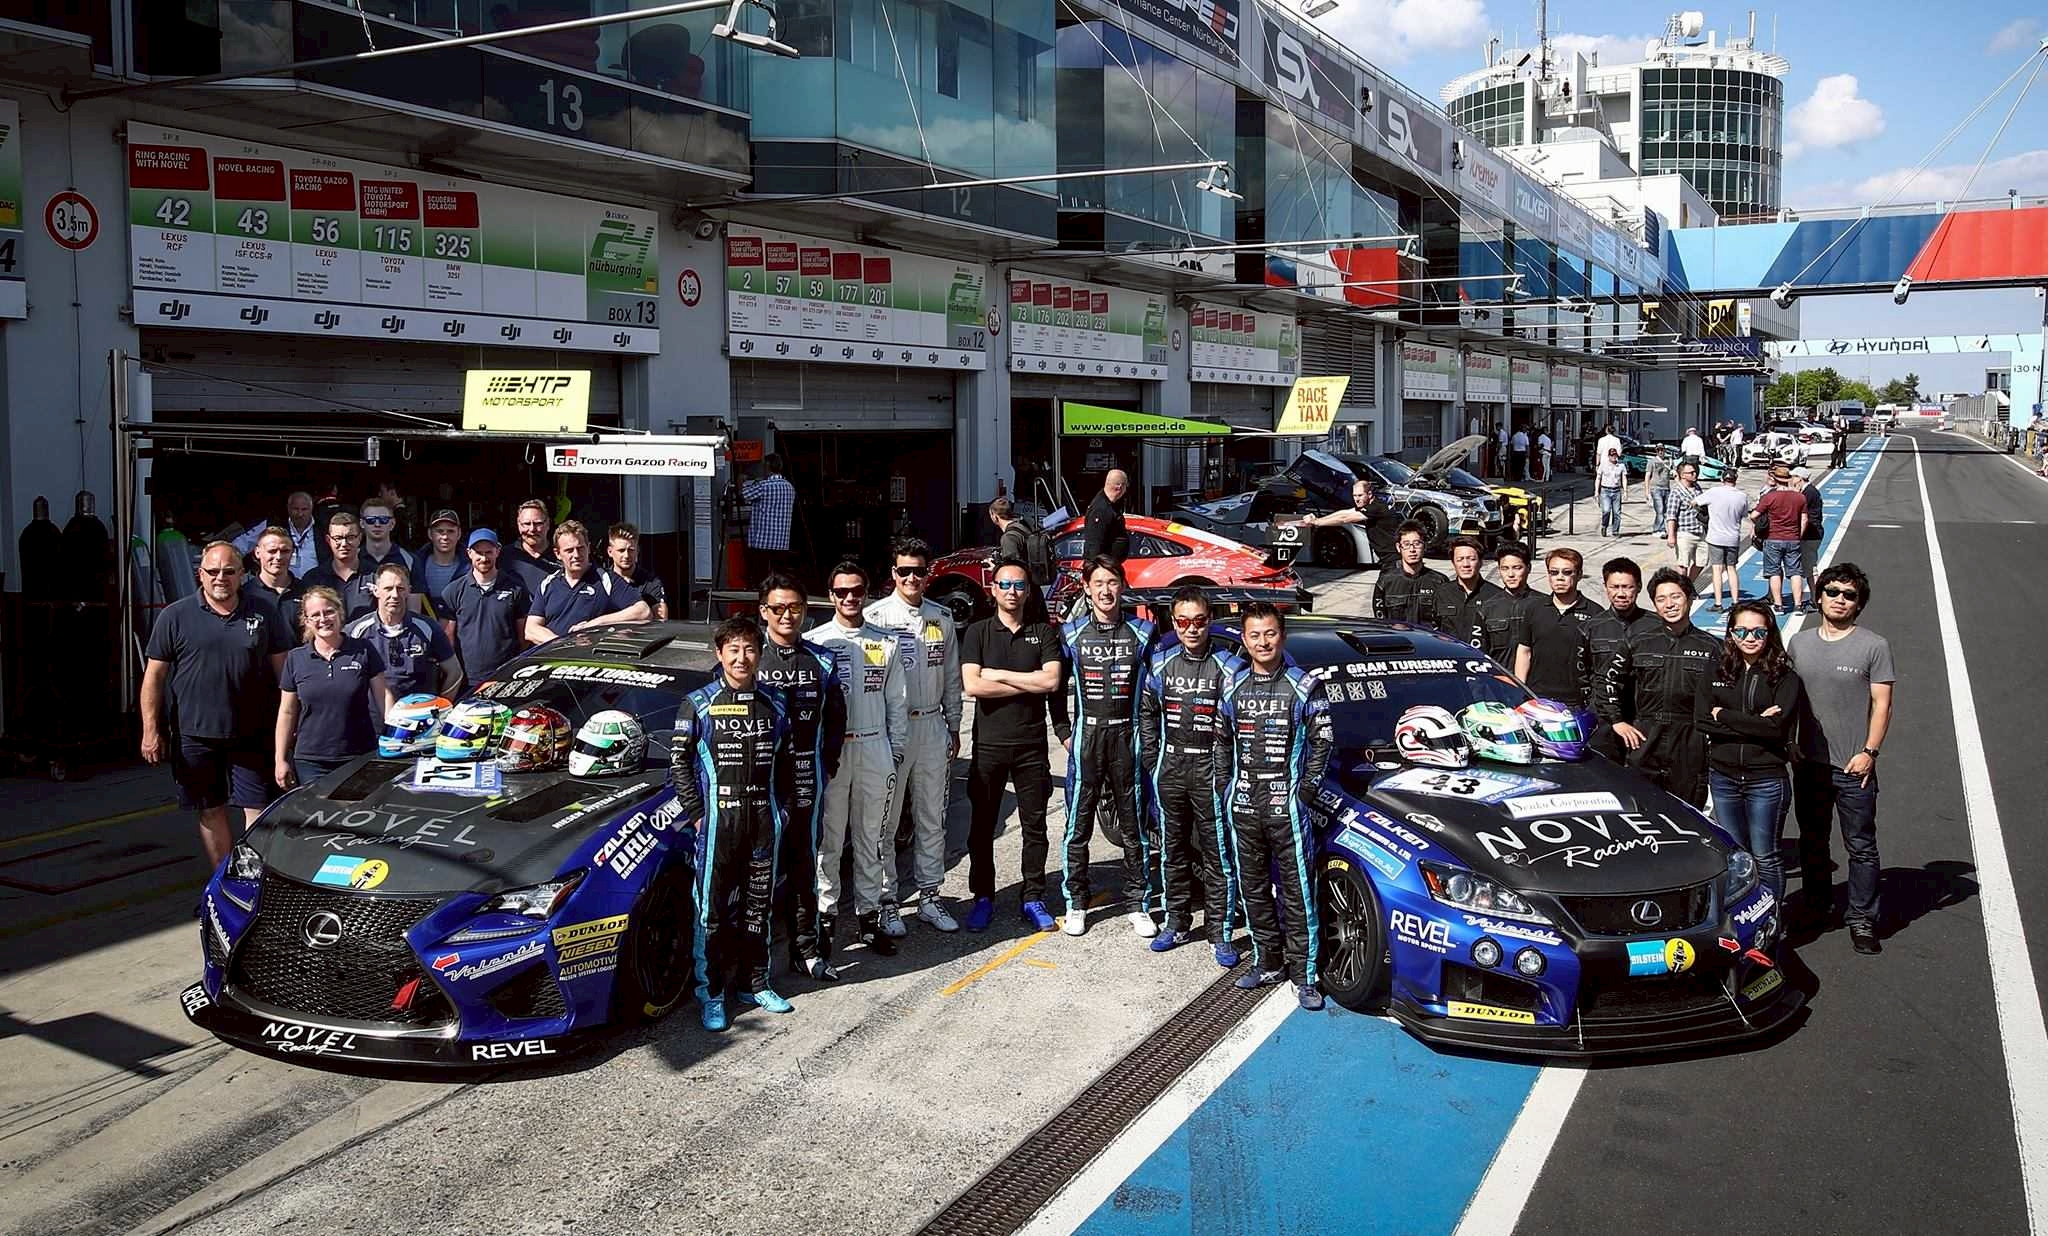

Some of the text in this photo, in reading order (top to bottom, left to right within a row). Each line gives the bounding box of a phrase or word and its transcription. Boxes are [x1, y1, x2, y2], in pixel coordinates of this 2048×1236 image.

[1163, 8, 1190, 33] Center
[539, 79, 584, 131] 13
[135, 151, 190, 161] RING RACING
[136, 159, 188, 169] WITH NOVEL
[218, 163, 275, 174] NOVEL RACING
[294, 175, 348, 185] TOYOTA GAZOO
[295, 183, 322, 191] RACING
[364, 201, 409, 209] MOTORSPORT
[952, 188, 971, 216] 12
[156, 199, 191, 226] 42
[238, 209, 268, 235] 43
[312, 217, 339, 243] 56
[161, 232, 187, 242] LEXUS
[375, 226, 412, 251] 115
[166, 242, 183, 251] RCF
[241, 241, 266, 251] LEXUS
[315, 249, 338, 258] LEXUS
[435, 234, 472, 258] 325
[322, 258, 332, 266] LC
[381, 257, 405, 265] TOYOTA
[590, 260, 642, 278] nürburgring
[743, 272, 752, 289] 2
[776, 277, 791, 294] 57
[810, 281, 824, 298] 59
[840, 285, 858, 302] 177
[869, 289, 886, 305] 201
[159, 300, 191, 320] dji
[240, 305, 269, 325] dji
[608, 301, 656, 324] BOX 13
[314, 310, 340, 329] dji
[381, 315, 405, 333] dji
[442, 320, 465, 337] dji
[501, 323, 521, 341] dji
[553, 328, 573, 344] dji
[613, 332, 631, 347] dji
[973, 331, 984, 348] 12
[1857, 341, 1929, 351] HYUNDAI
[2014, 365, 2040, 373] i30 N
[482, 397, 563, 407] MOTORSPORT
[1298, 388, 1327, 403] RACE
[1298, 405, 1328, 422] TAXI
[1071, 421, 1186, 433] www.getspeed.de
[580, 457, 621, 465] TOYOTA
[625, 457, 665, 466] GAZOO
[668, 458, 707, 469] Racing
[1081, 646, 1132, 656] NOVEL
[552, 665, 668, 685] GRAN TURISMO
[758, 670, 817, 681] NOVEL
[1346, 660, 1454, 674] GRAN TURISMO
[1166, 676, 1217, 689] NOVEL
[1237, 700, 1288, 711] NOVEL
[715, 719, 774, 730] NOVEL
[1422, 774, 1480, 794] 43
[302, 810, 477, 846] NOVEL
[1364, 812, 1429, 850] FALKEN
[304, 832, 448, 851] Racing
[594, 812, 647, 867] FALKEN
[1475, 814, 1700, 860] NOVEL
[610, 831, 653, 874] DRL
[1528, 836, 1688, 867] Racing
[569, 919, 627, 938] DUNLOP
[1391, 909, 1457, 948] REVEL
[560, 938, 616, 960] NIESEN
[1397, 933, 1447, 954] MOTOR SPORTS
[1632, 952, 1665, 965] BILSTEIN
[181, 985, 211, 1016] REVEL
[1465, 1007, 1531, 1019] DUNLOP
[260, 1021, 358, 1050] NOVEL
[265, 1041, 341, 1056] Racing
[472, 1039, 556, 1061] REVEL
